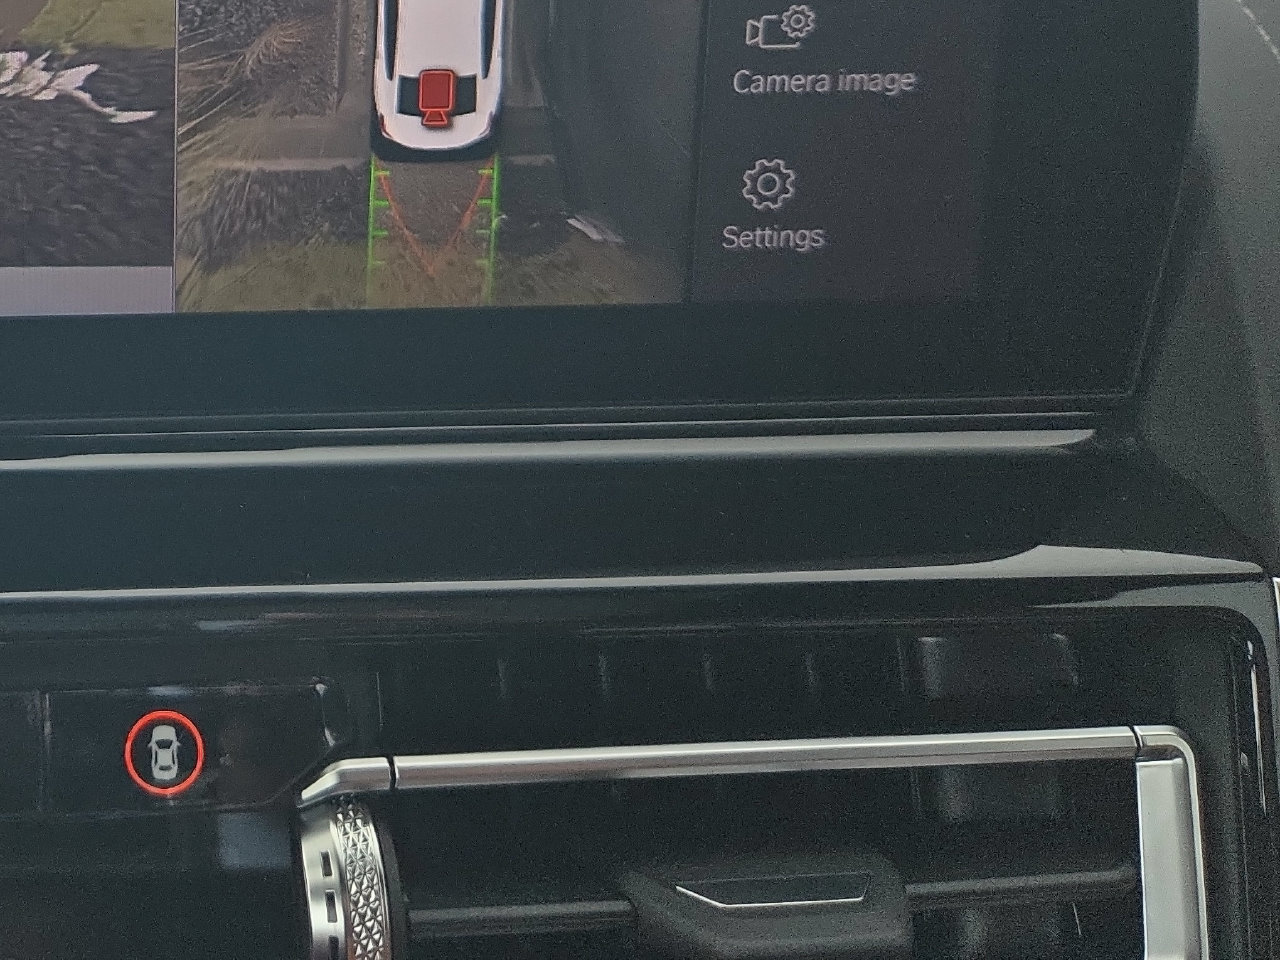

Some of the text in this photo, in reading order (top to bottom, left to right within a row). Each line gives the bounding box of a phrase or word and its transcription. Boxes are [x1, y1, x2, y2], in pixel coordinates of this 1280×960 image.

[732, 68, 917, 97] Camera image
[722, 225, 825, 252] Settings
